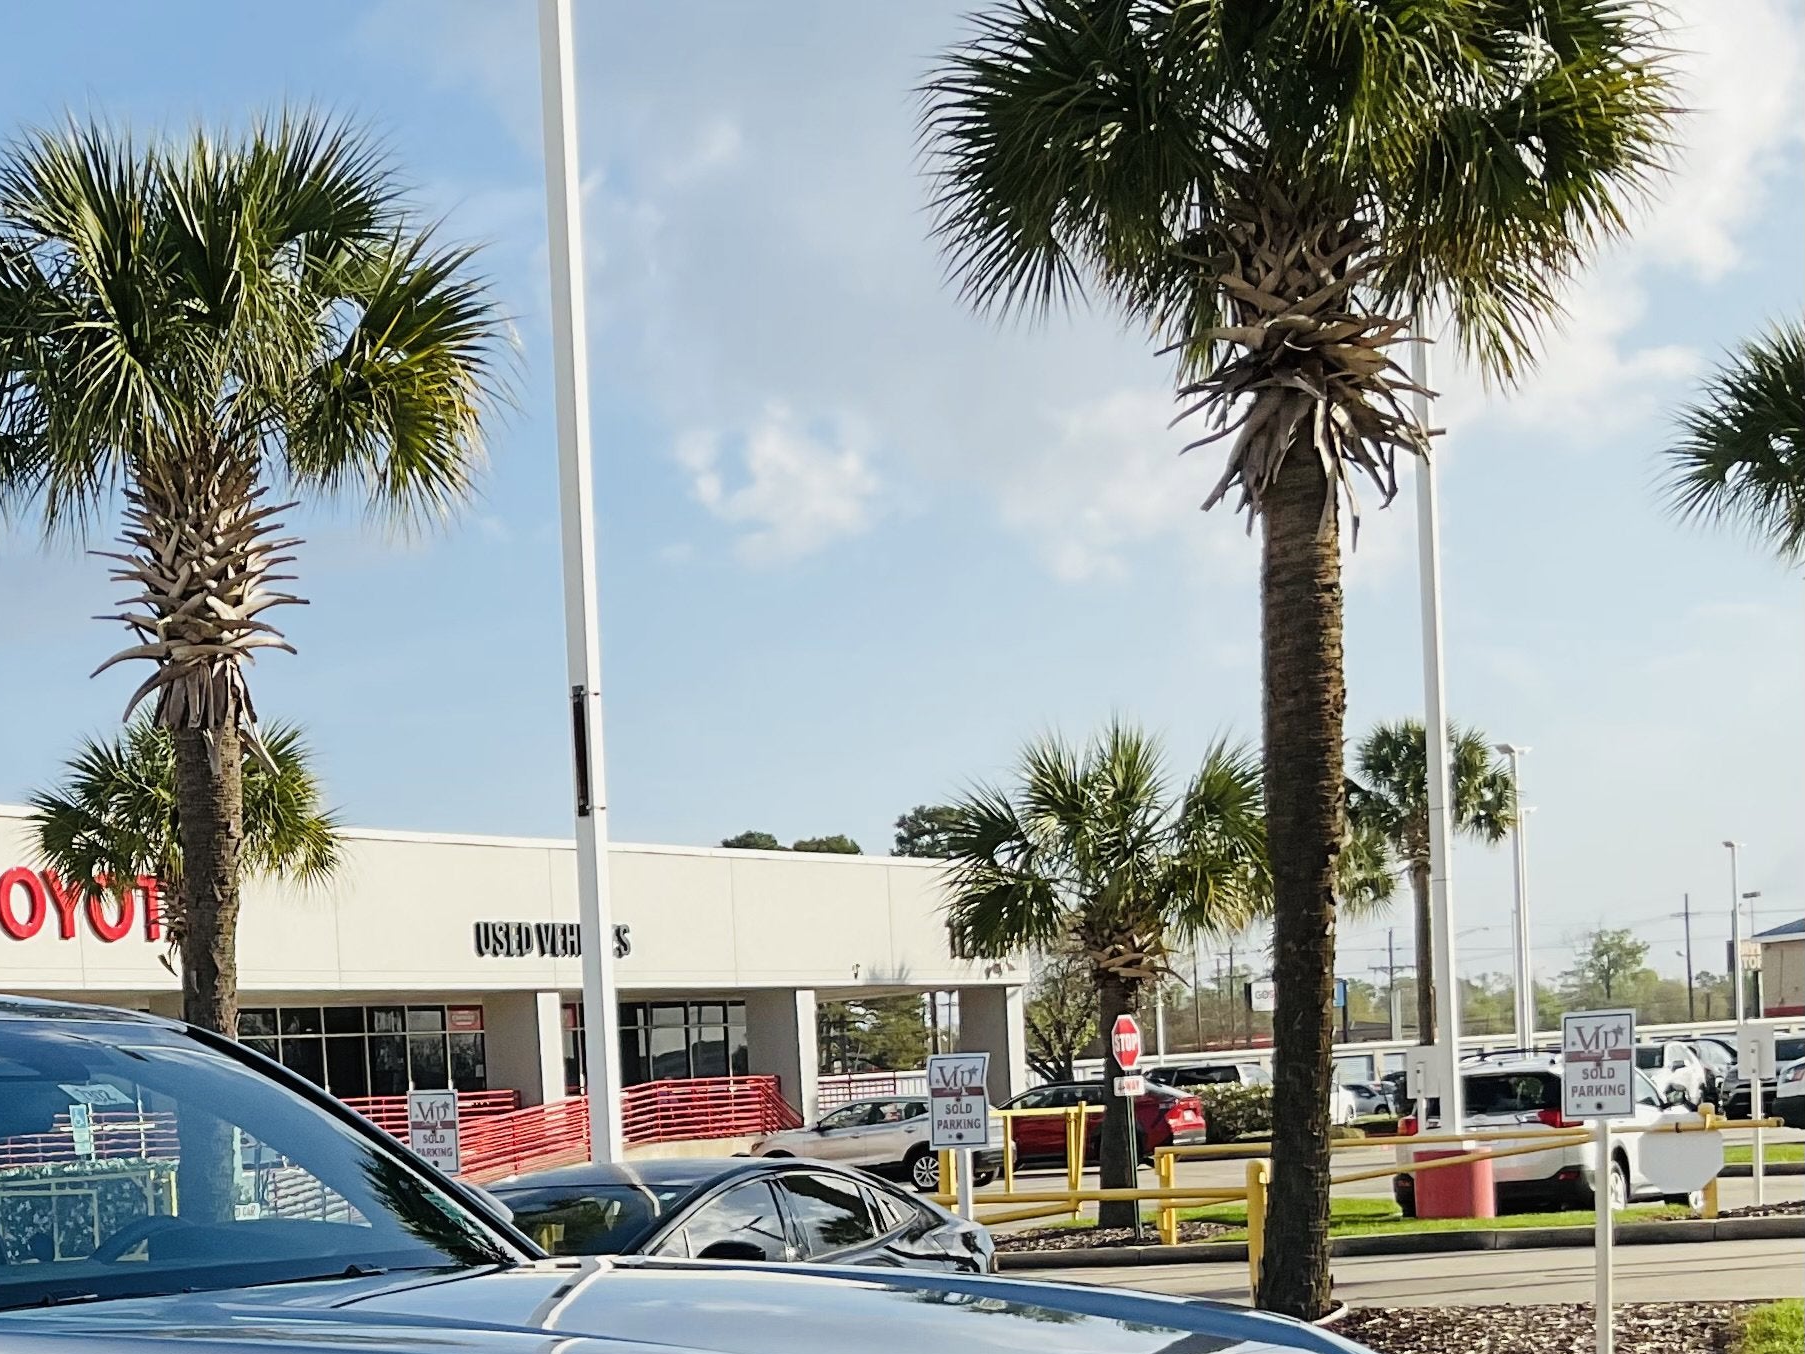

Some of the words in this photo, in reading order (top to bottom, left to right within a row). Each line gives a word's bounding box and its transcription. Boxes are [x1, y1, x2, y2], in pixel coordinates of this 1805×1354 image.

[474, 921, 533, 957] USED
[1115, 1033, 1137, 1052] STOP
[1582, 1067, 1615, 1080] SOLD
[1571, 1084, 1626, 1097] PARKING
[945, 1103, 972, 1114] SOLD
[937, 1118, 981, 1130] PARKING
[423, 1134, 445, 1143] SOLD
[417, 1147, 453, 1157] PARKING
